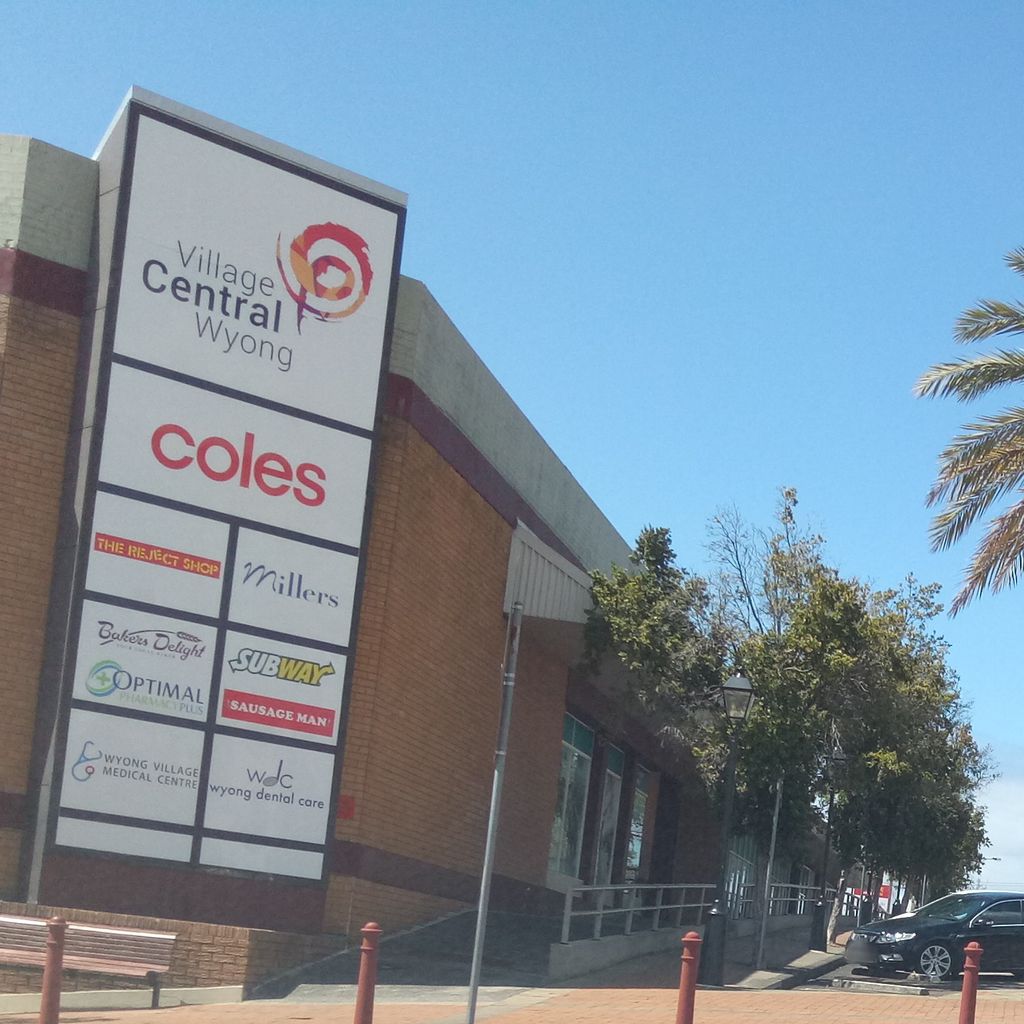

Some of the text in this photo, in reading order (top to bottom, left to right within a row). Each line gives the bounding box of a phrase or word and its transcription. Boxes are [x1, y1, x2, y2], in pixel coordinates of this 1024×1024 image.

[178, 240, 274, 296] Village
[142, 259, 282, 333] Central
[196, 312, 292, 372] Wyong
[151, 423, 326, 507] coles
[97, 538, 219, 575] THE REJECT SHOP
[243, 562, 339, 608] Millers
[98, 621, 148, 646] Bakers
[153, 633, 206, 661] Delight
[113, 670, 204, 704] OPTIMAL
[228, 648, 336, 687] SUBWAY
[230, 700, 328, 727] SAUSAGE MAN
[102, 766, 198, 790] MEDICAL CENTRE
[104, 753, 199, 778] WYONG VILLAGE
[210, 784, 325, 809] wyong dental care
